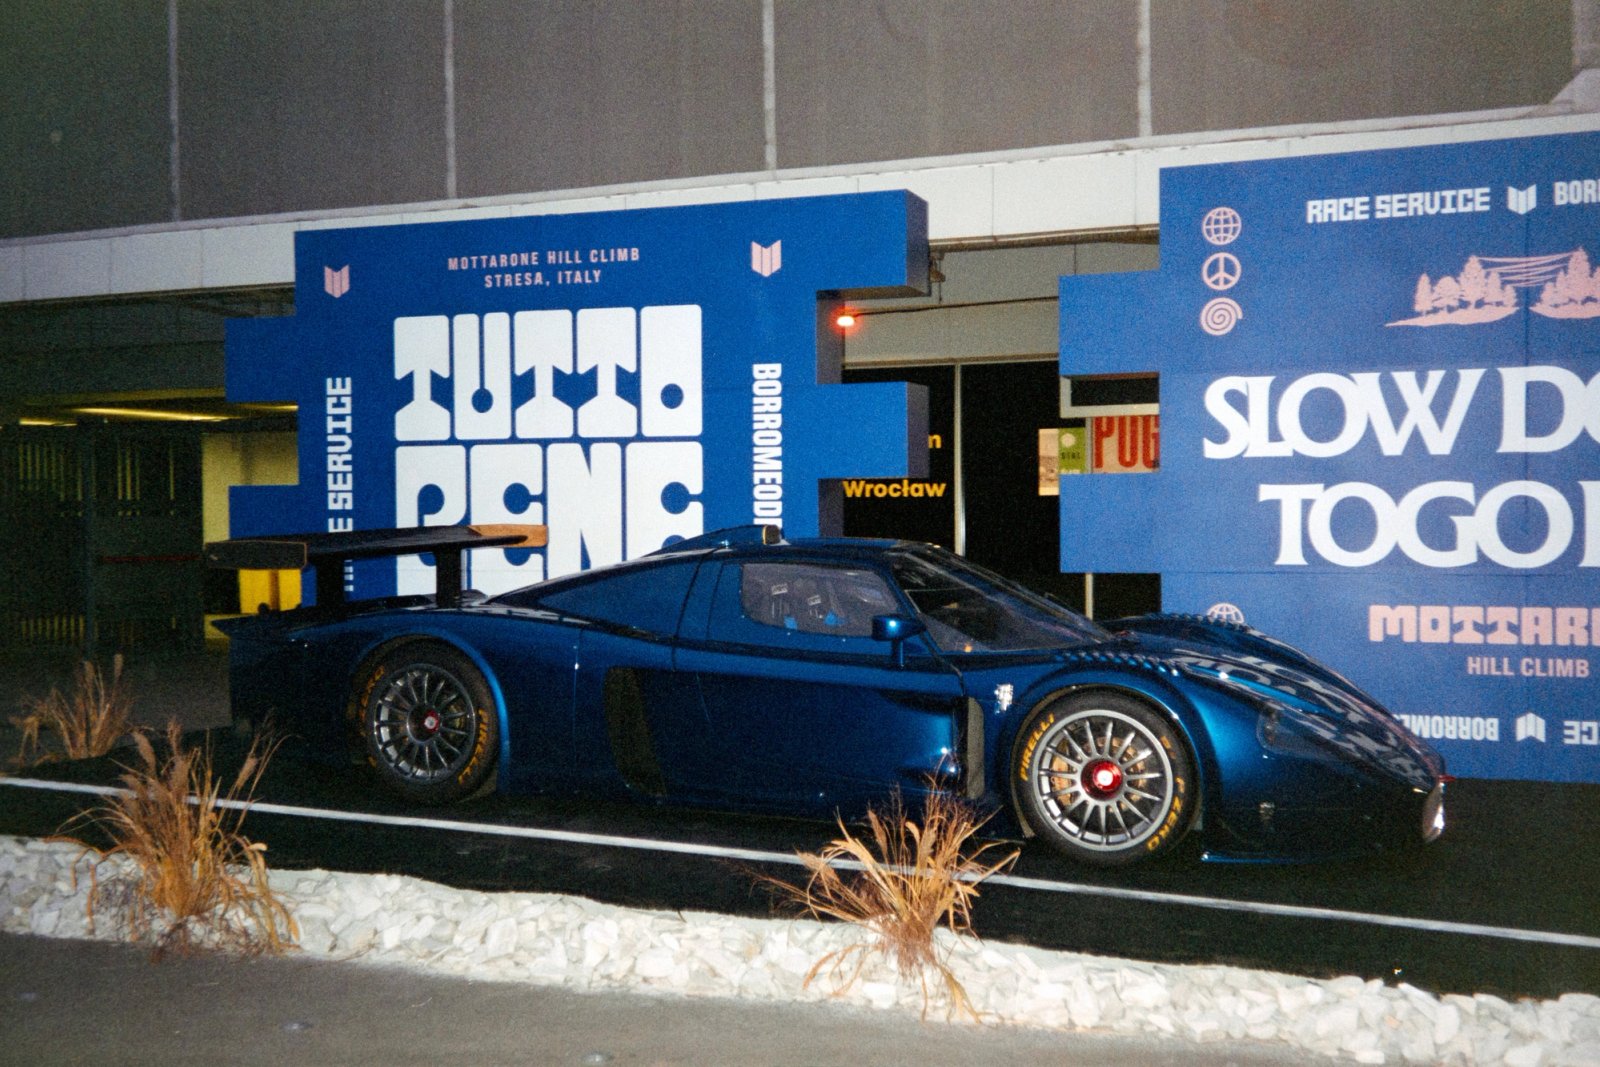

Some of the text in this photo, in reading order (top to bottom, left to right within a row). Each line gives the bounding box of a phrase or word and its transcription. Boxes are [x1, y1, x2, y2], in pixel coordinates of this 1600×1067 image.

[1306, 178, 1600, 223] RACE SERVICE BOR
[448, 247, 641, 271] MOTTARONE HILL CLIMB
[484, 269, 602, 288] STRESA, ITALY
[394, 304, 702, 441] TUTTO
[1203, 365, 1600, 459] SLOW D
[326, 376, 353, 510] SERVICE
[842, 479, 947, 498] Wrocław
[1467, 656, 1590, 678] HILL CLIMB
[1019, 713, 1055, 782] PIRELLI
